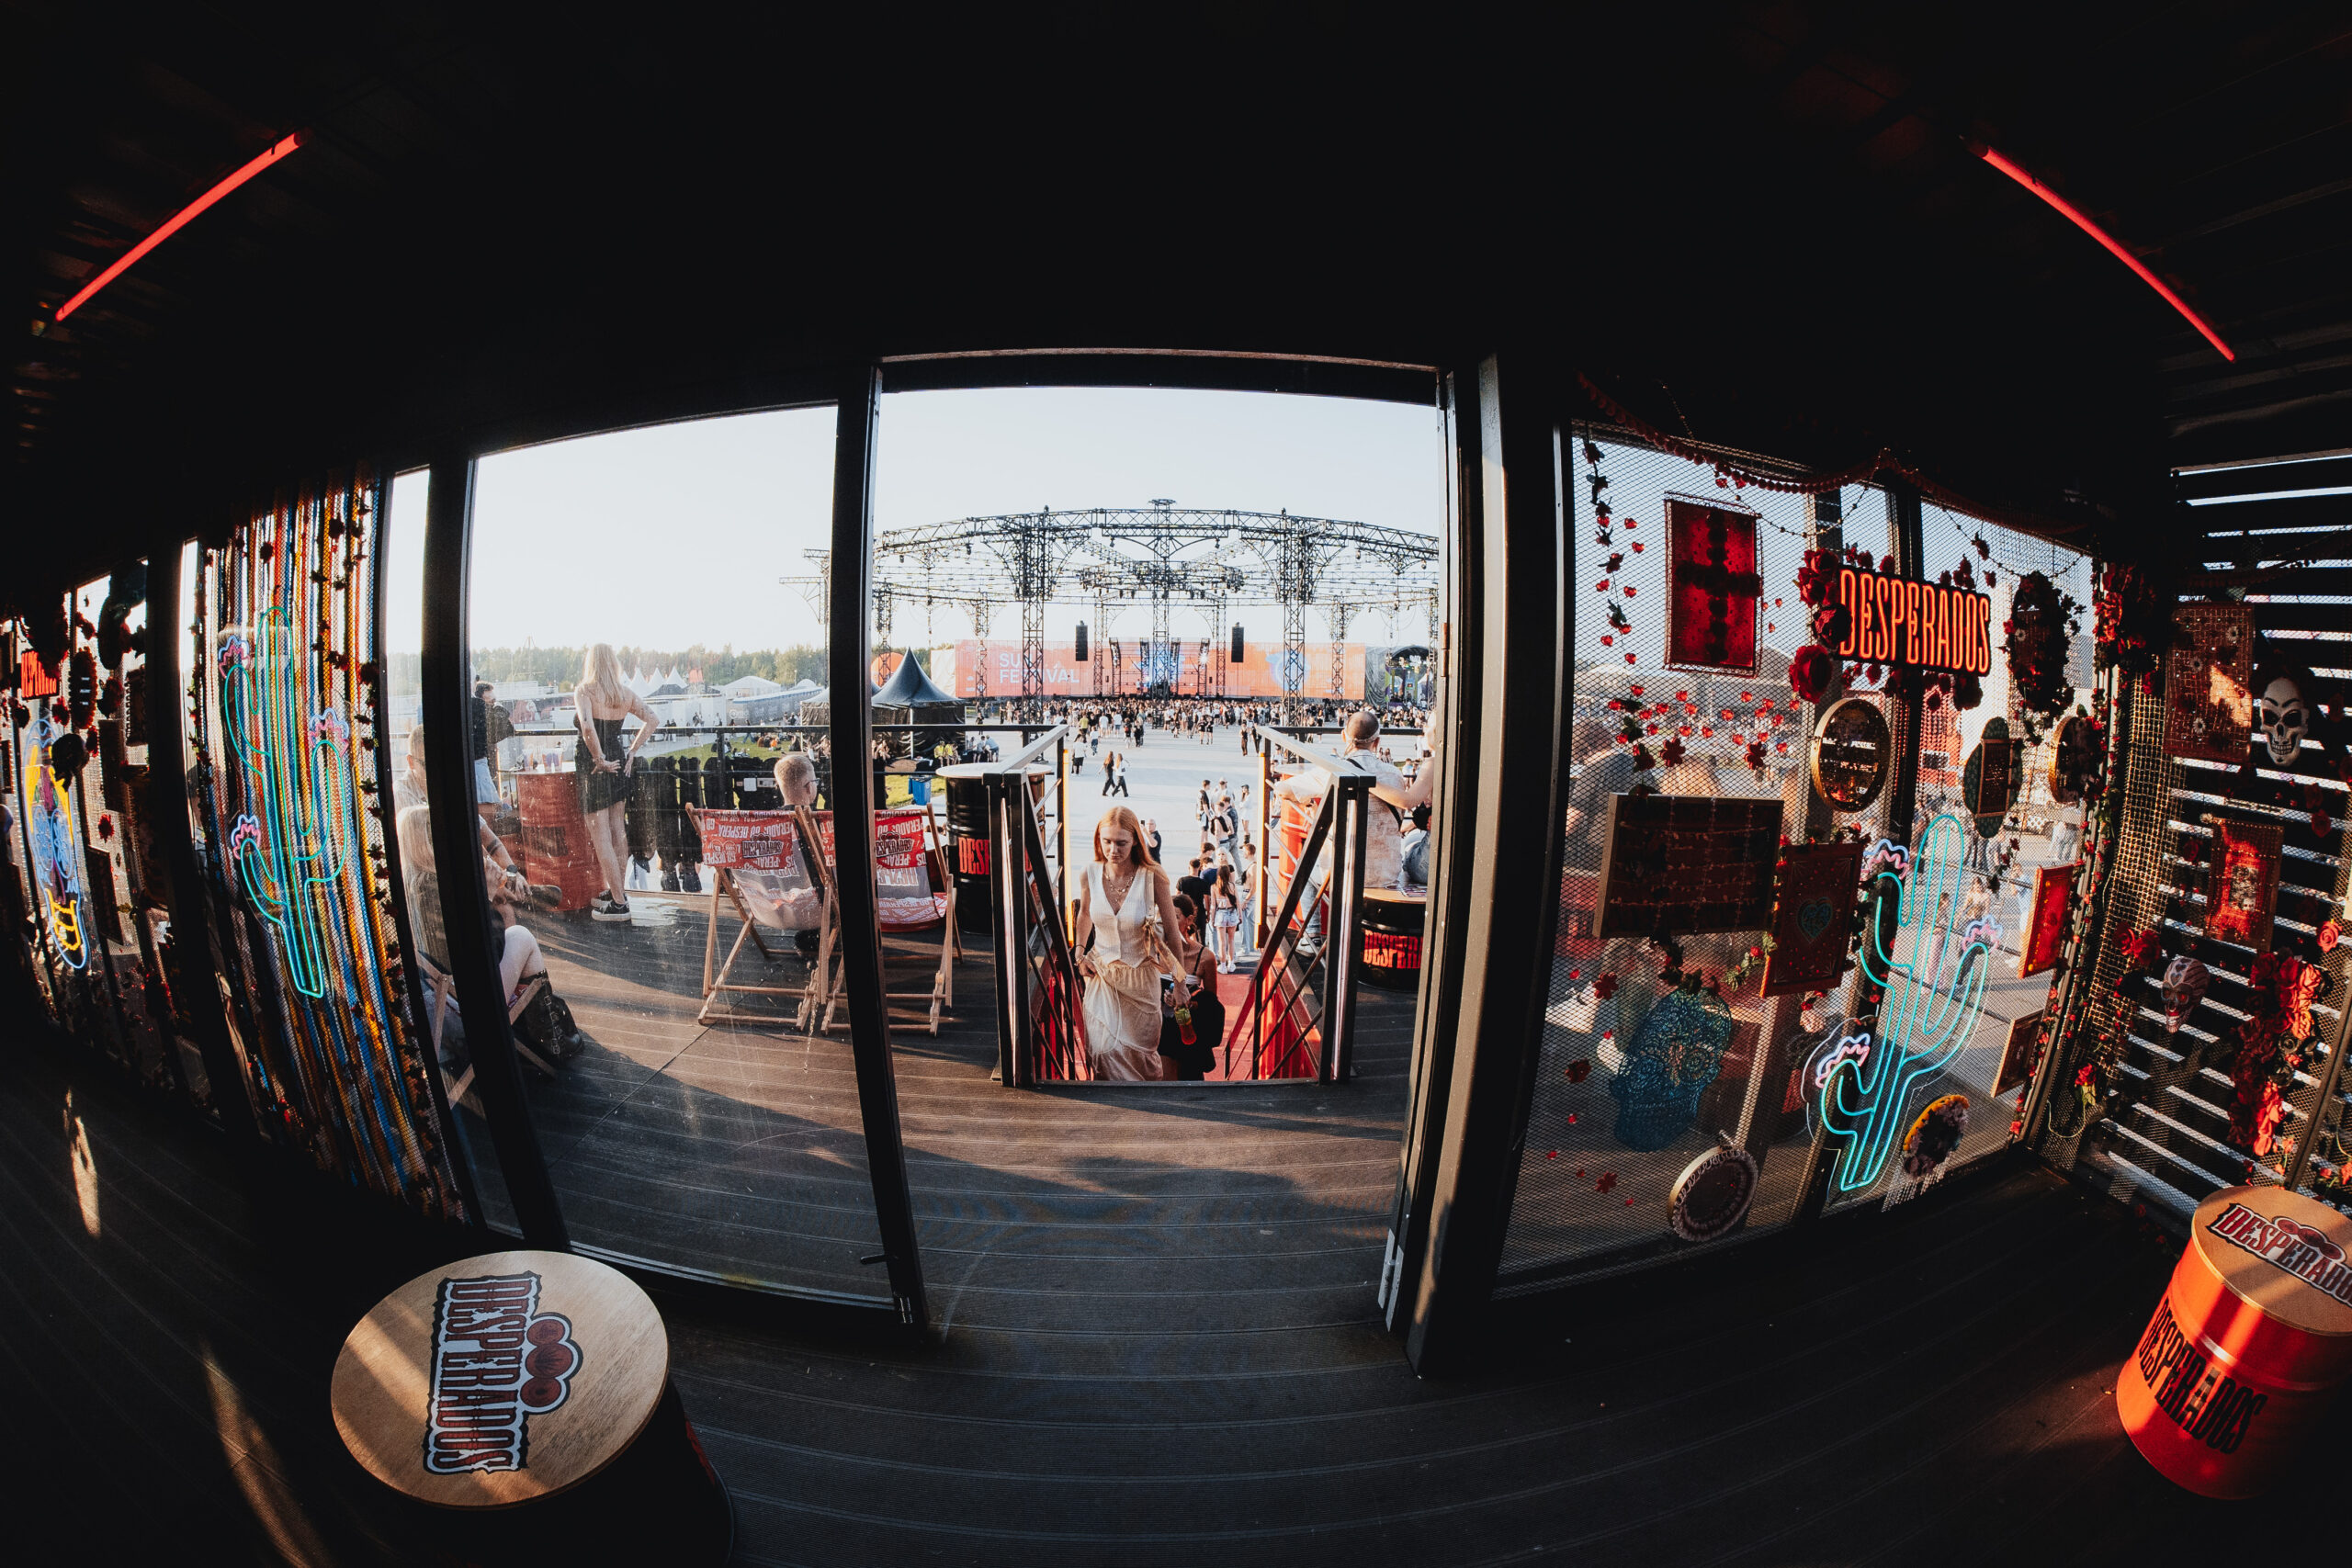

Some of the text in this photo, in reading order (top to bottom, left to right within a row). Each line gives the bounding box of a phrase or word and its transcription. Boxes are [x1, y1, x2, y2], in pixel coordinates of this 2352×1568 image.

[1839, 569, 1991, 674] DESPERADOS
[430, 1277, 535, 1470] DESPERADOS
[2139, 1296, 2268, 1454] DESPERADOS
